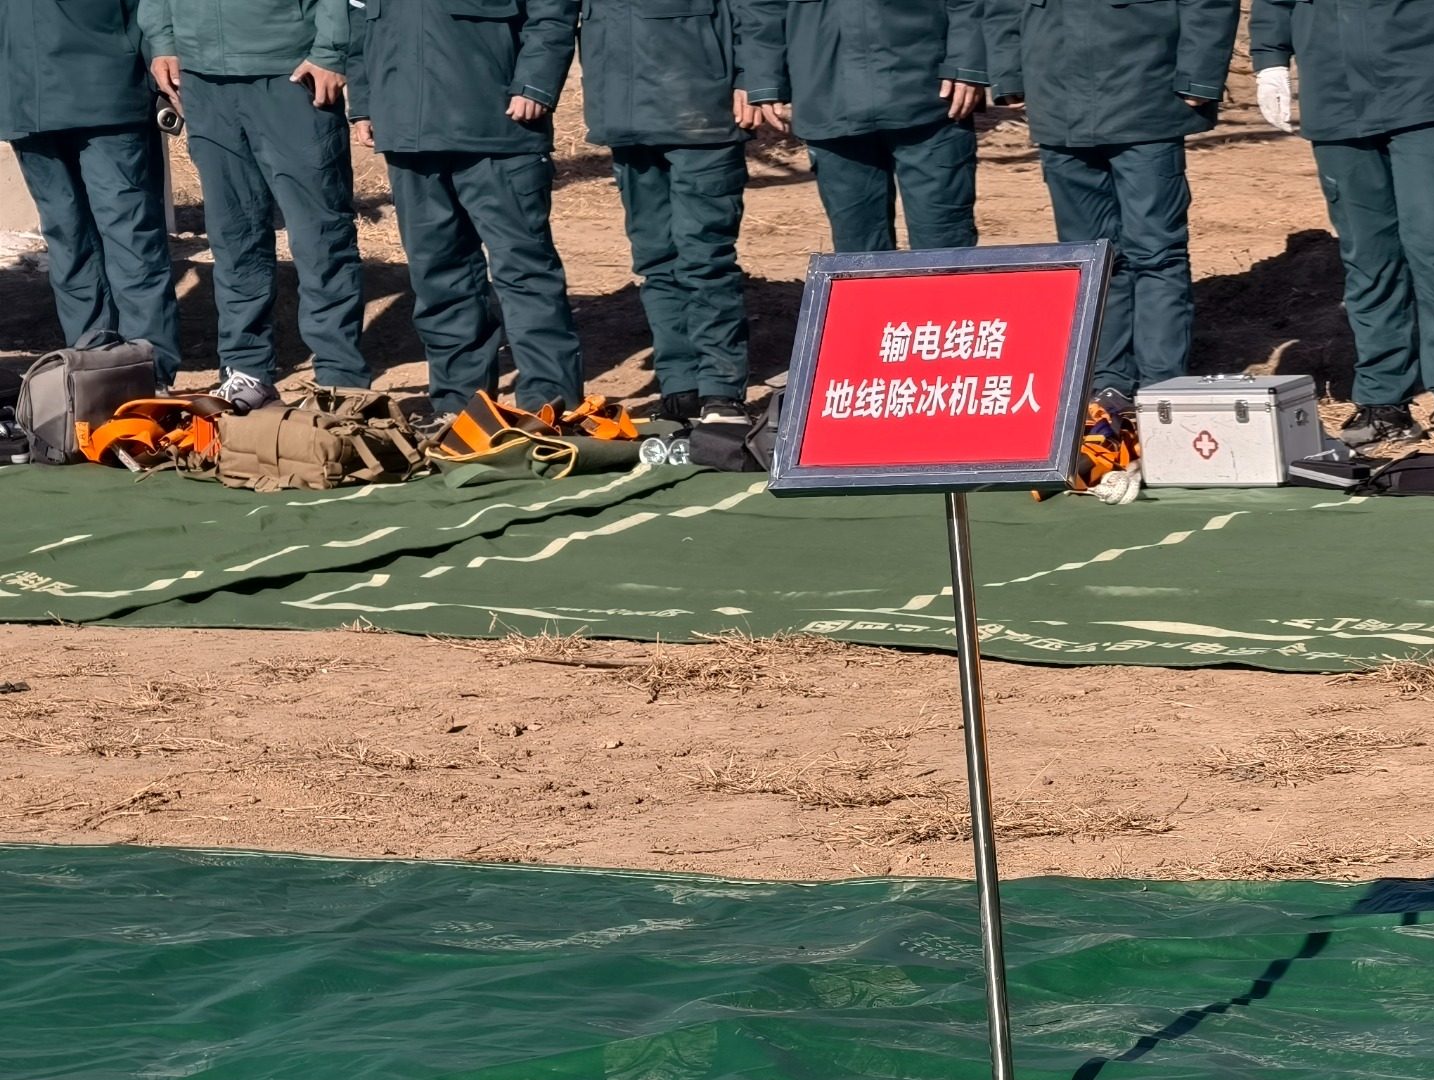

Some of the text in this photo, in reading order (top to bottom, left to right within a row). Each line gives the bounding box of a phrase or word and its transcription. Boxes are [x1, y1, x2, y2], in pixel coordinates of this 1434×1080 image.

[879, 318, 1008, 362] 输电线路
[822, 374, 1040, 419] 地线除冰机器人
